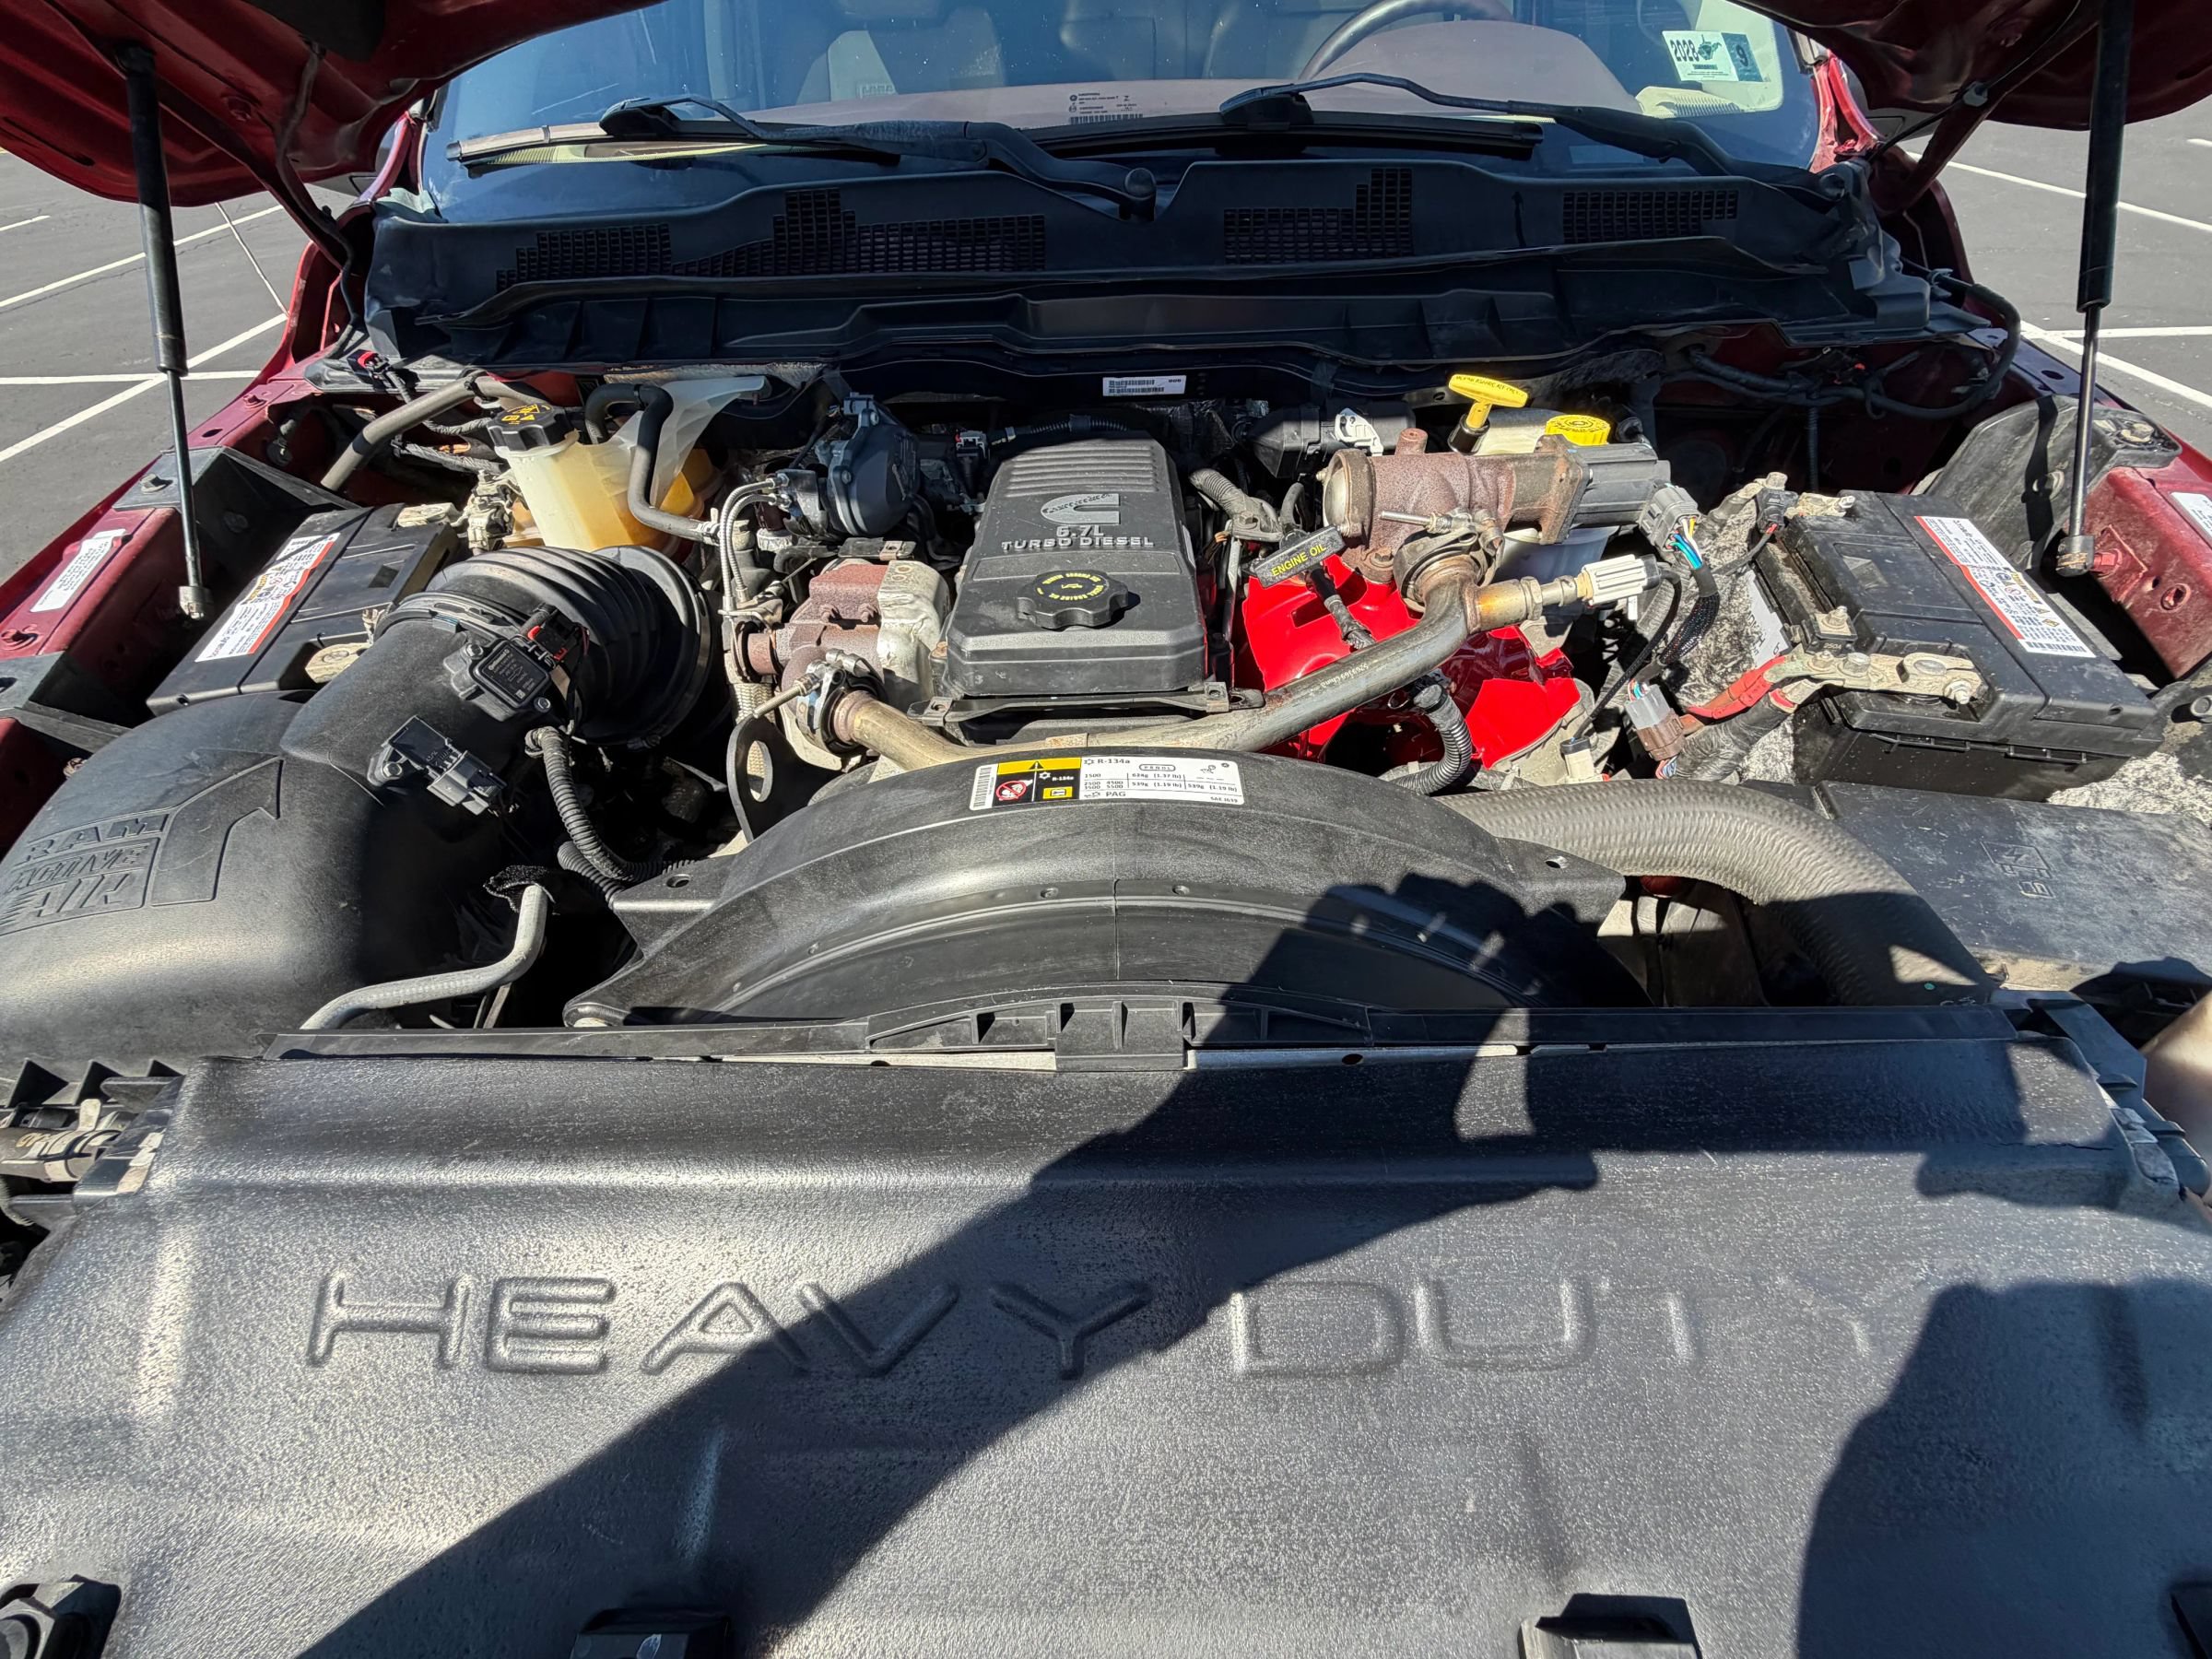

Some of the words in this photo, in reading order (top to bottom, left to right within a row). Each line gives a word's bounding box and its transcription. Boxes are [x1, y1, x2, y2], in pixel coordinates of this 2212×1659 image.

[1670, 39, 1700, 62] 2028
[1735, 44, 1748, 66] 9
[1001, 537, 1073, 551] TURBO
[1080, 536, 1155, 547] DIESEL
[1056, 524, 1105, 537] 6.7L
[1271, 551, 1309, 576] ENGINE
[1309, 544, 1327, 558] OIL
[24, 814, 170, 863] RAM
[305, 1272, 1154, 1381] HEAVY
[1227, 1270, 1934, 1378] DUTY
